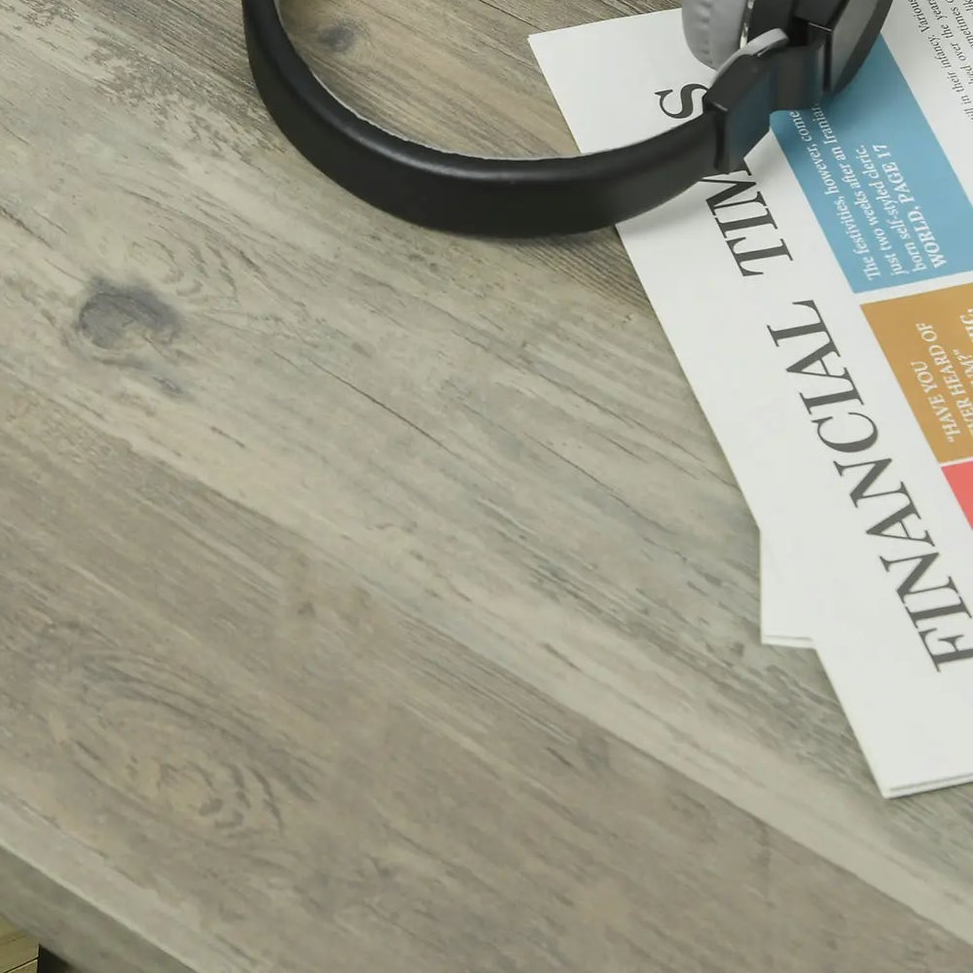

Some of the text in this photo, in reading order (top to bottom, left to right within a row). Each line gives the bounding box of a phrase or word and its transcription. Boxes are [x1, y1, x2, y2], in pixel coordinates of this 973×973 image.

[940, 24, 954, 39] the
[950, 6, 973, 48] metimes
[928, 34, 952, 69] infancy.
[950, 42, 967, 62] over
[947, 71, 965, 93] their
[960, 94, 972, 106] in
[831, 146, 847, 162] an
[871, 143, 892, 159] 17
[839, 162, 861, 190] after
[881, 161, 915, 204] PAGE
[790, 110, 882, 281] The festivities, however, come
[854, 190, 879, 226] weeks
[856, 144, 927, 273] born self-styled cleric.
[873, 227, 892, 252] two
[884, 254, 910, 276] just
[915, 322, 938, 343] OF
[655, 83, 973, 673] FINANCIAL TIMS
[910, 361, 938, 394] YOU
[928, 345, 967, 396] HEARD
